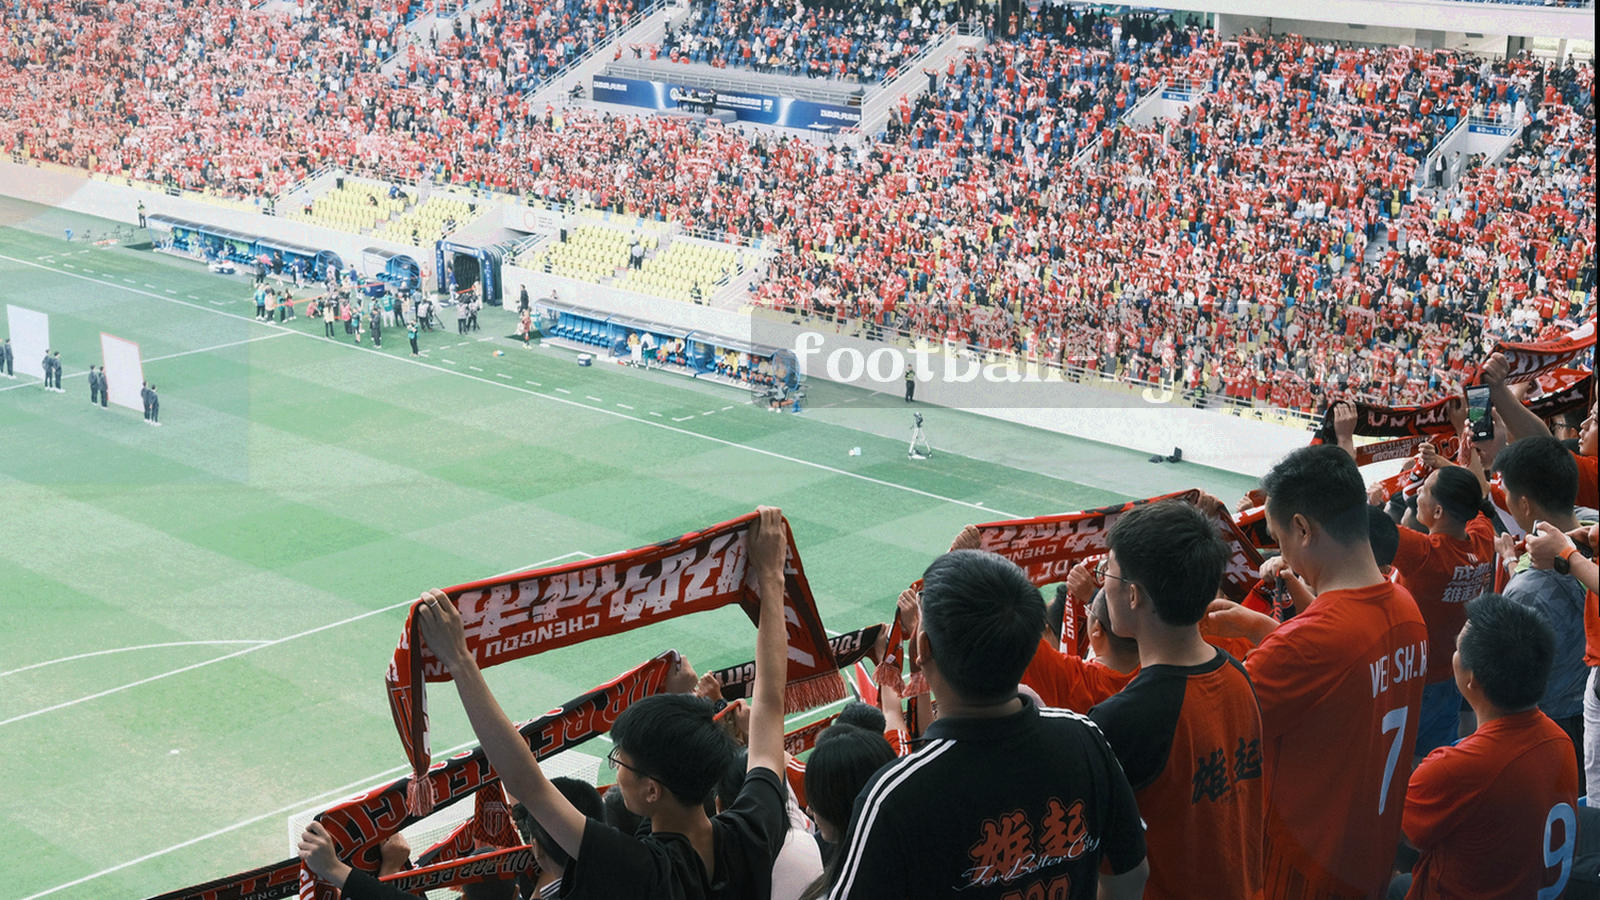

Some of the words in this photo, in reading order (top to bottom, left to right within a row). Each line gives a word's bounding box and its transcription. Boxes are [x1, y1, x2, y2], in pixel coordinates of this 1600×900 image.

[485, 613, 600, 658] CHENGDU
[1065, 593, 1075, 640] HENG
[1379, 706, 1408, 816] 7
[320, 790, 408, 861] CIT
[1537, 802, 1578, 900] 9
